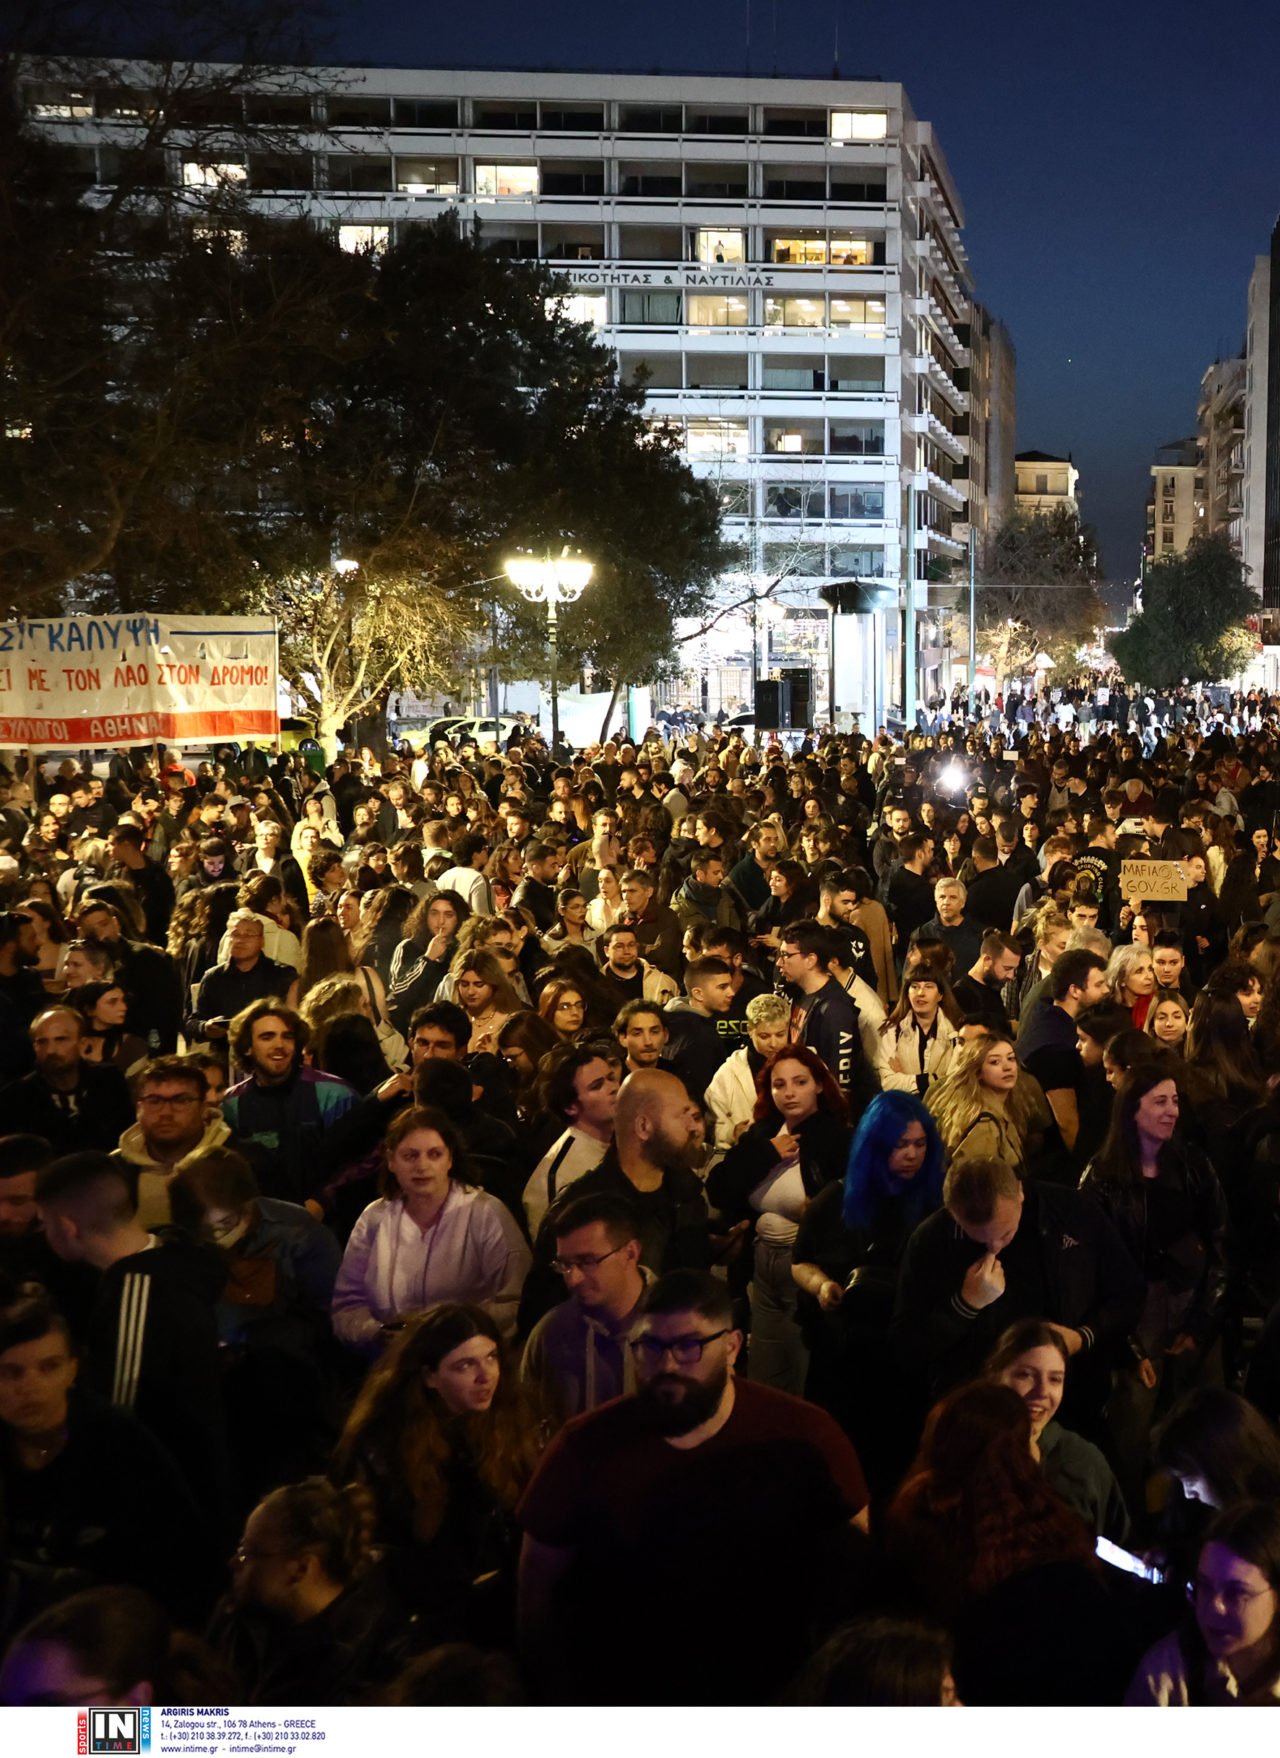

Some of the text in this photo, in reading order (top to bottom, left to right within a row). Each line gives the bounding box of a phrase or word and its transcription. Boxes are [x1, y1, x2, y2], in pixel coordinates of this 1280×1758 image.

[664, 275, 673, 285] &
[686, 274, 775, 287] ΝΑΥΤΙΛΙΑΣ
[28, 668, 51, 692] ΜΕ
[62, 667, 101, 692] ΤΟΝ
[114, 663, 149, 687] ΛΑΟ
[157, 663, 200, 686] ΣΤΟΝ
[209, 663, 268, 687] ΔΡΟΜΟ!
[1126, 879, 1180, 894] GOV.GR
